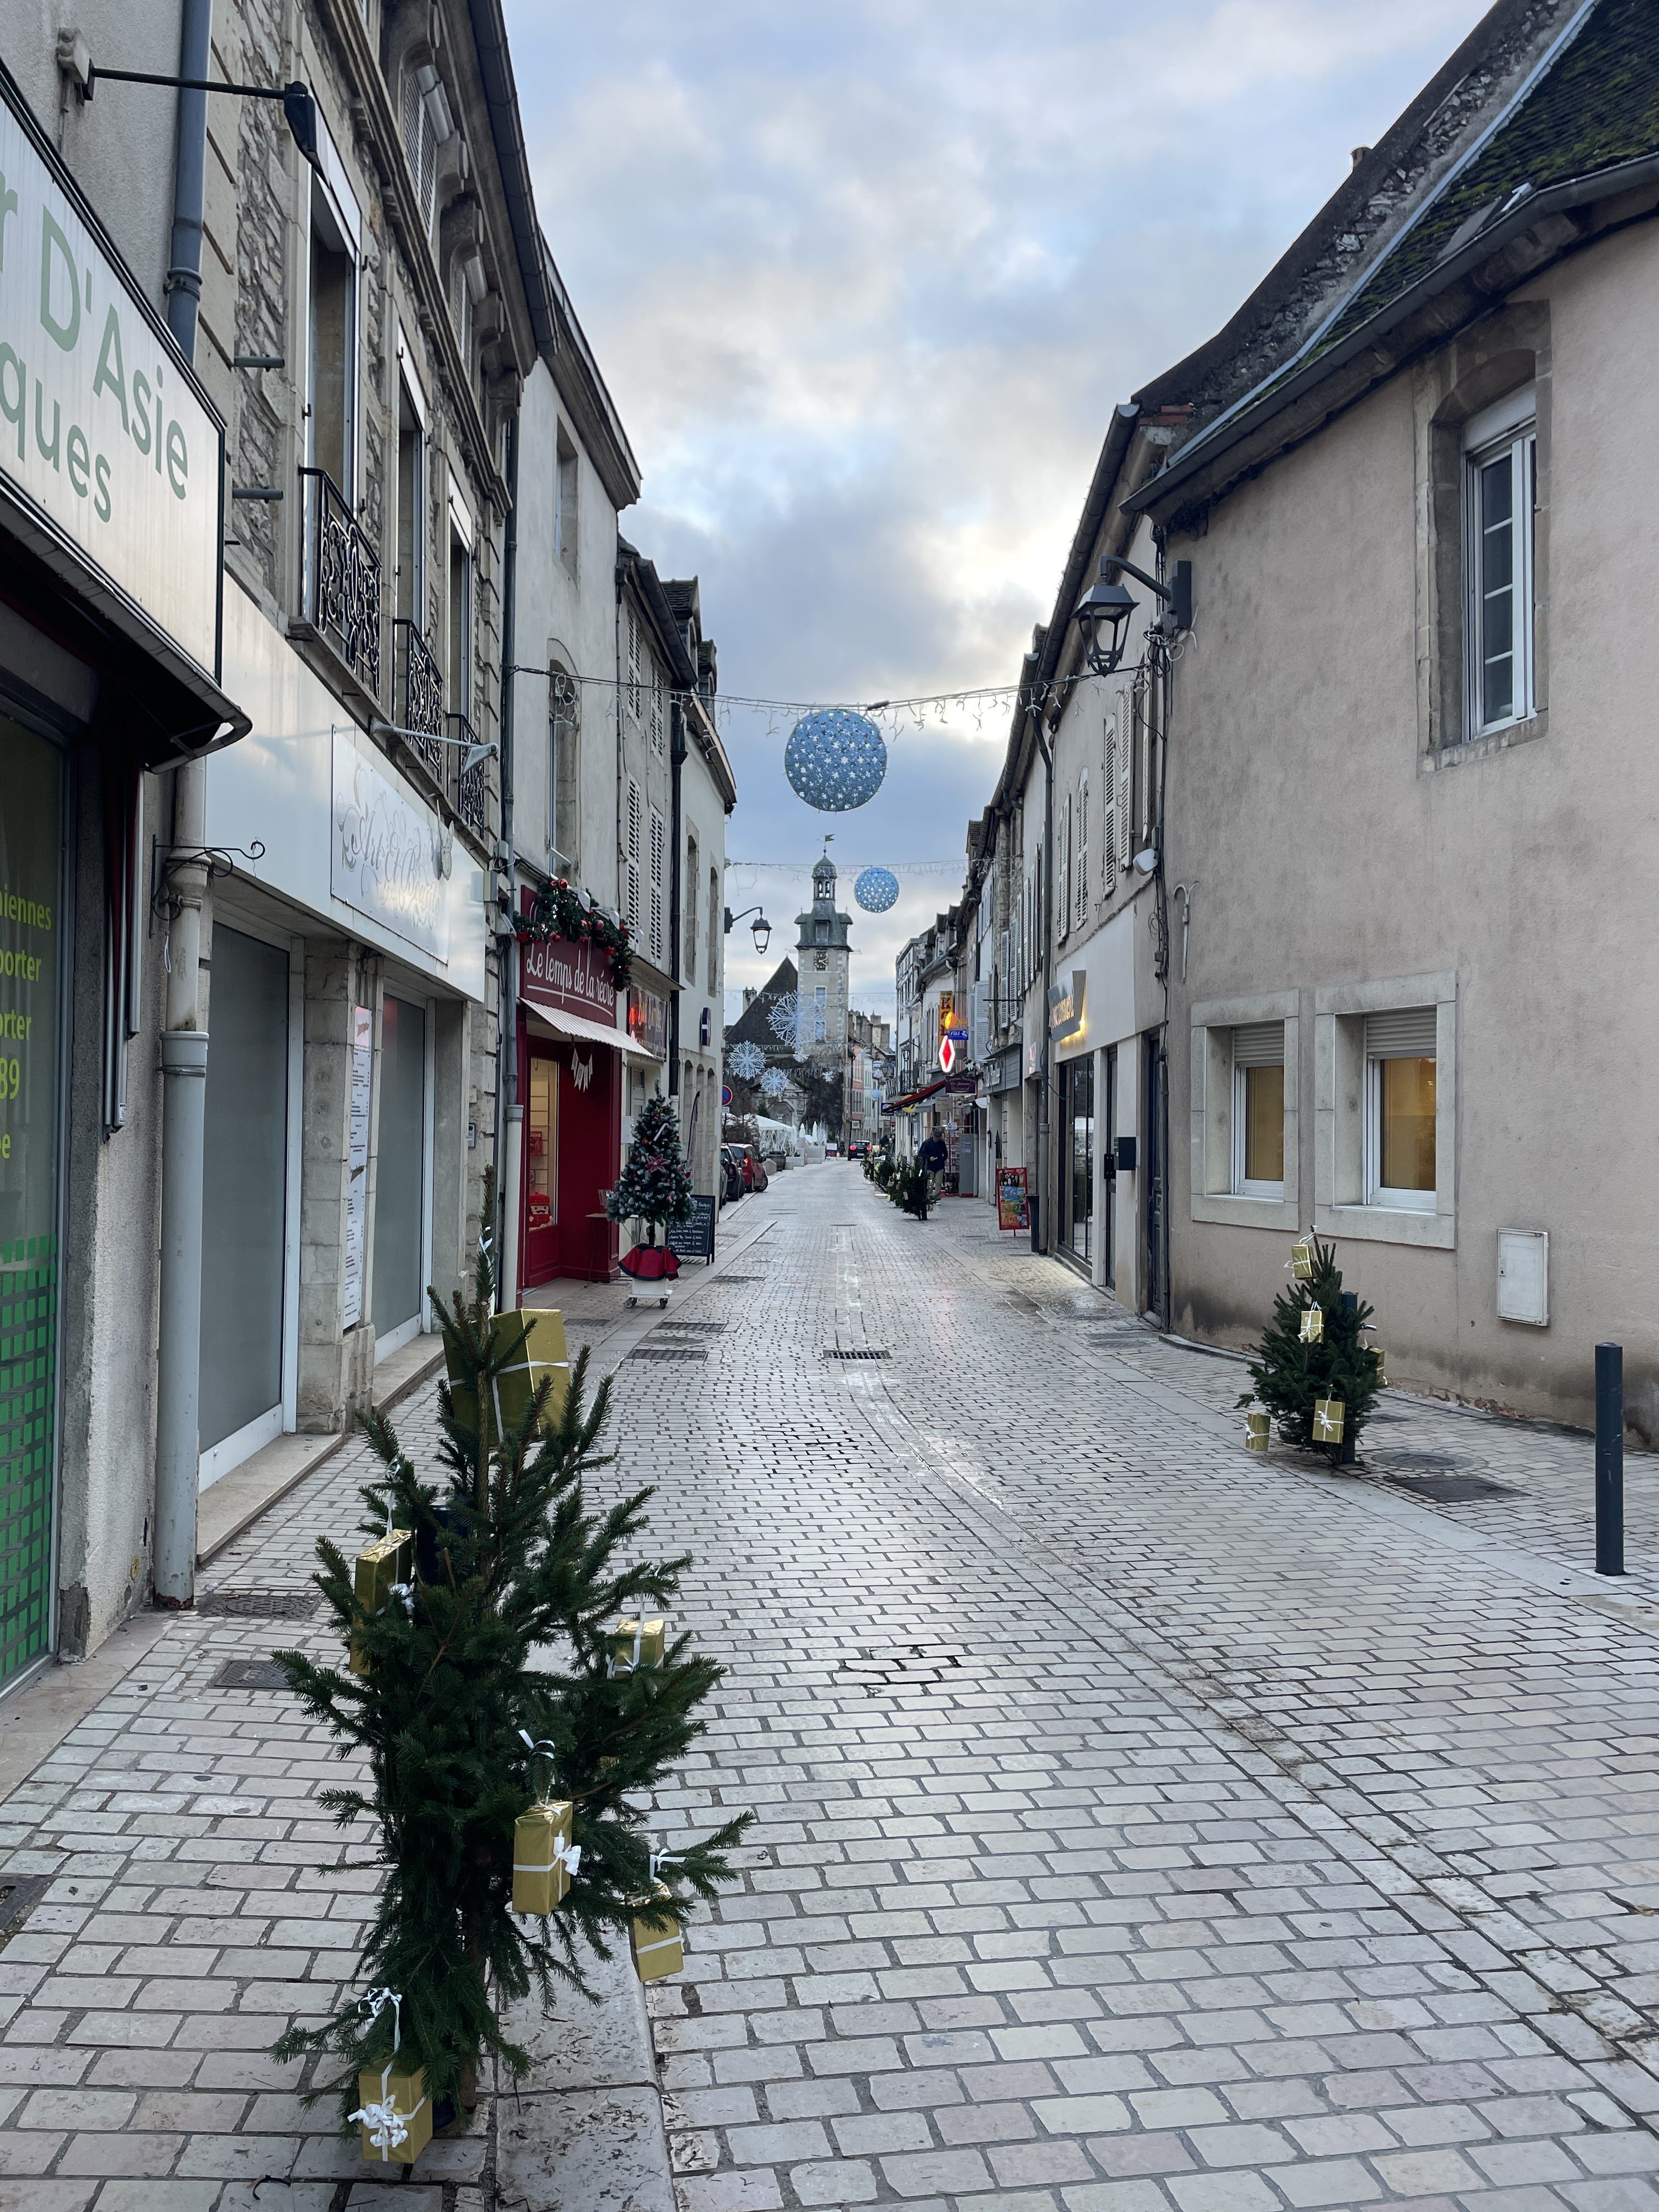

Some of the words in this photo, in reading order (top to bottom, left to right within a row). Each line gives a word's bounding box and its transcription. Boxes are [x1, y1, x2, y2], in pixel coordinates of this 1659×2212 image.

[41, 204, 188, 500] D'Asie
[574, 950, 584, 994] de
[586, 936, 595, 999] la
[596, 969, 614, 1007] récré
[0, 1133, 11, 1159] e
